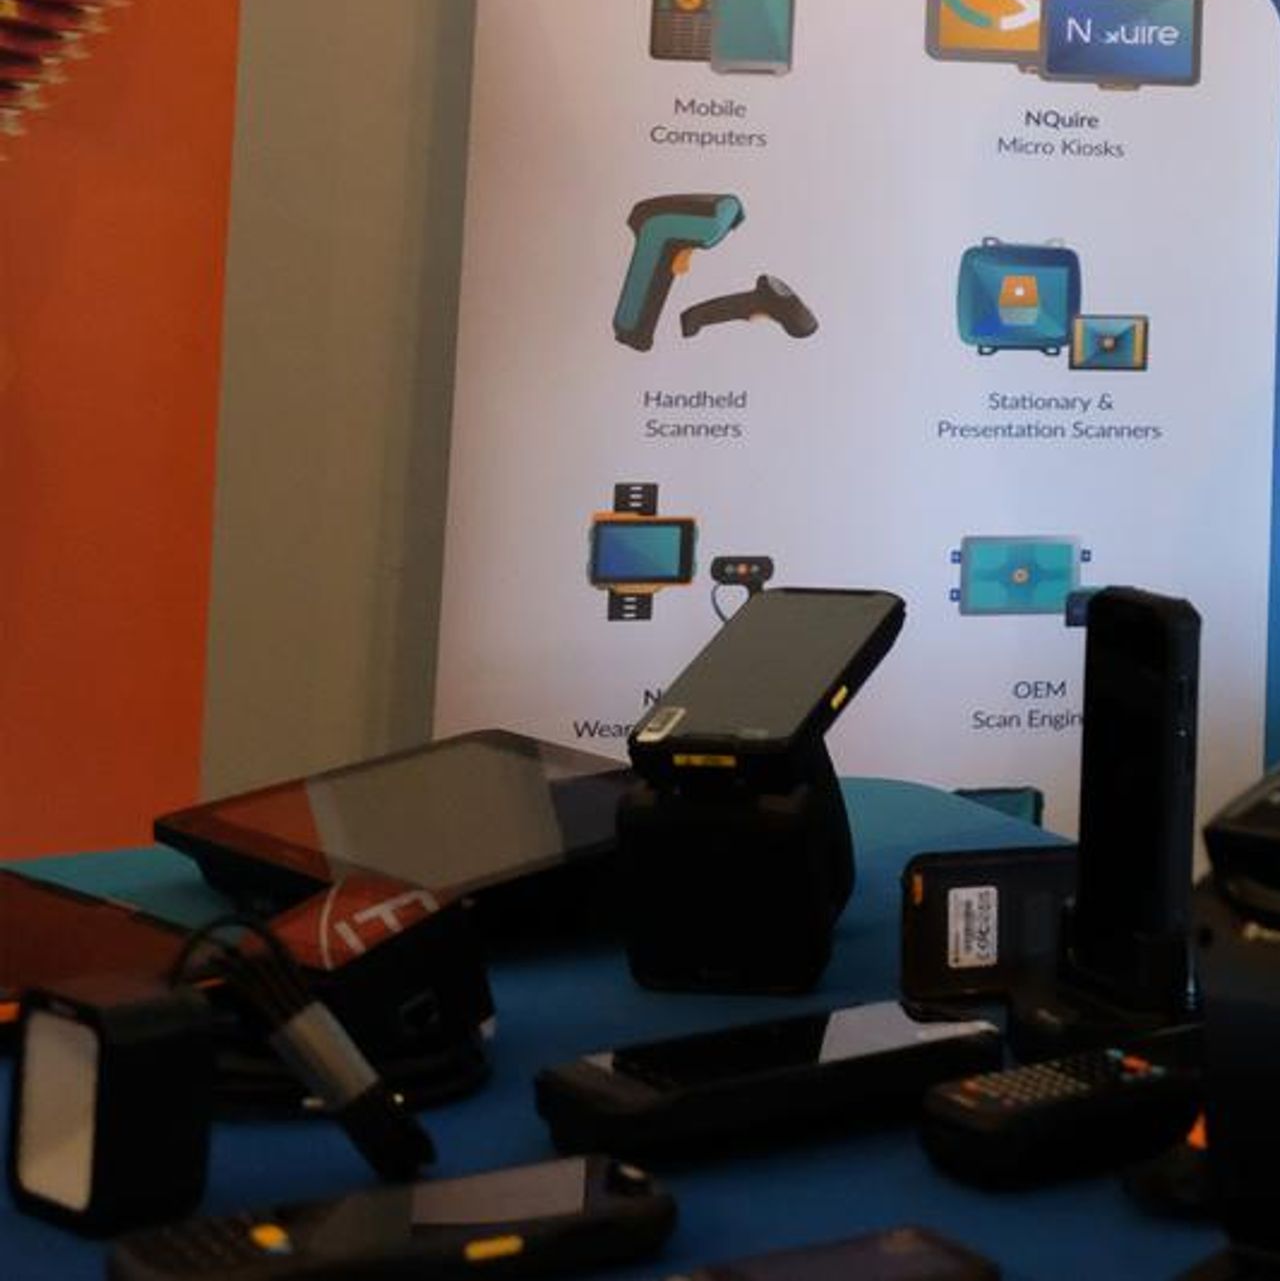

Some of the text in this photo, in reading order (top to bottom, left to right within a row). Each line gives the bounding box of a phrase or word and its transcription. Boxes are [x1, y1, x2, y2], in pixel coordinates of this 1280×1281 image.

[674, 98, 747, 118] Mobile
[1025, 110, 1100, 130] NQuire
[650, 125, 768, 148] Computers
[998, 137, 1125, 158] Micro Kiosks
[643, 390, 748, 409] Handheld
[988, 392, 1114, 413] Stationary &
[644, 419, 742, 439] Scanners
[937, 421, 1163, 440] Presentation Scanners
[1014, 681, 1067, 699] OEM
[972, 709, 1084, 732] Scan Engin
